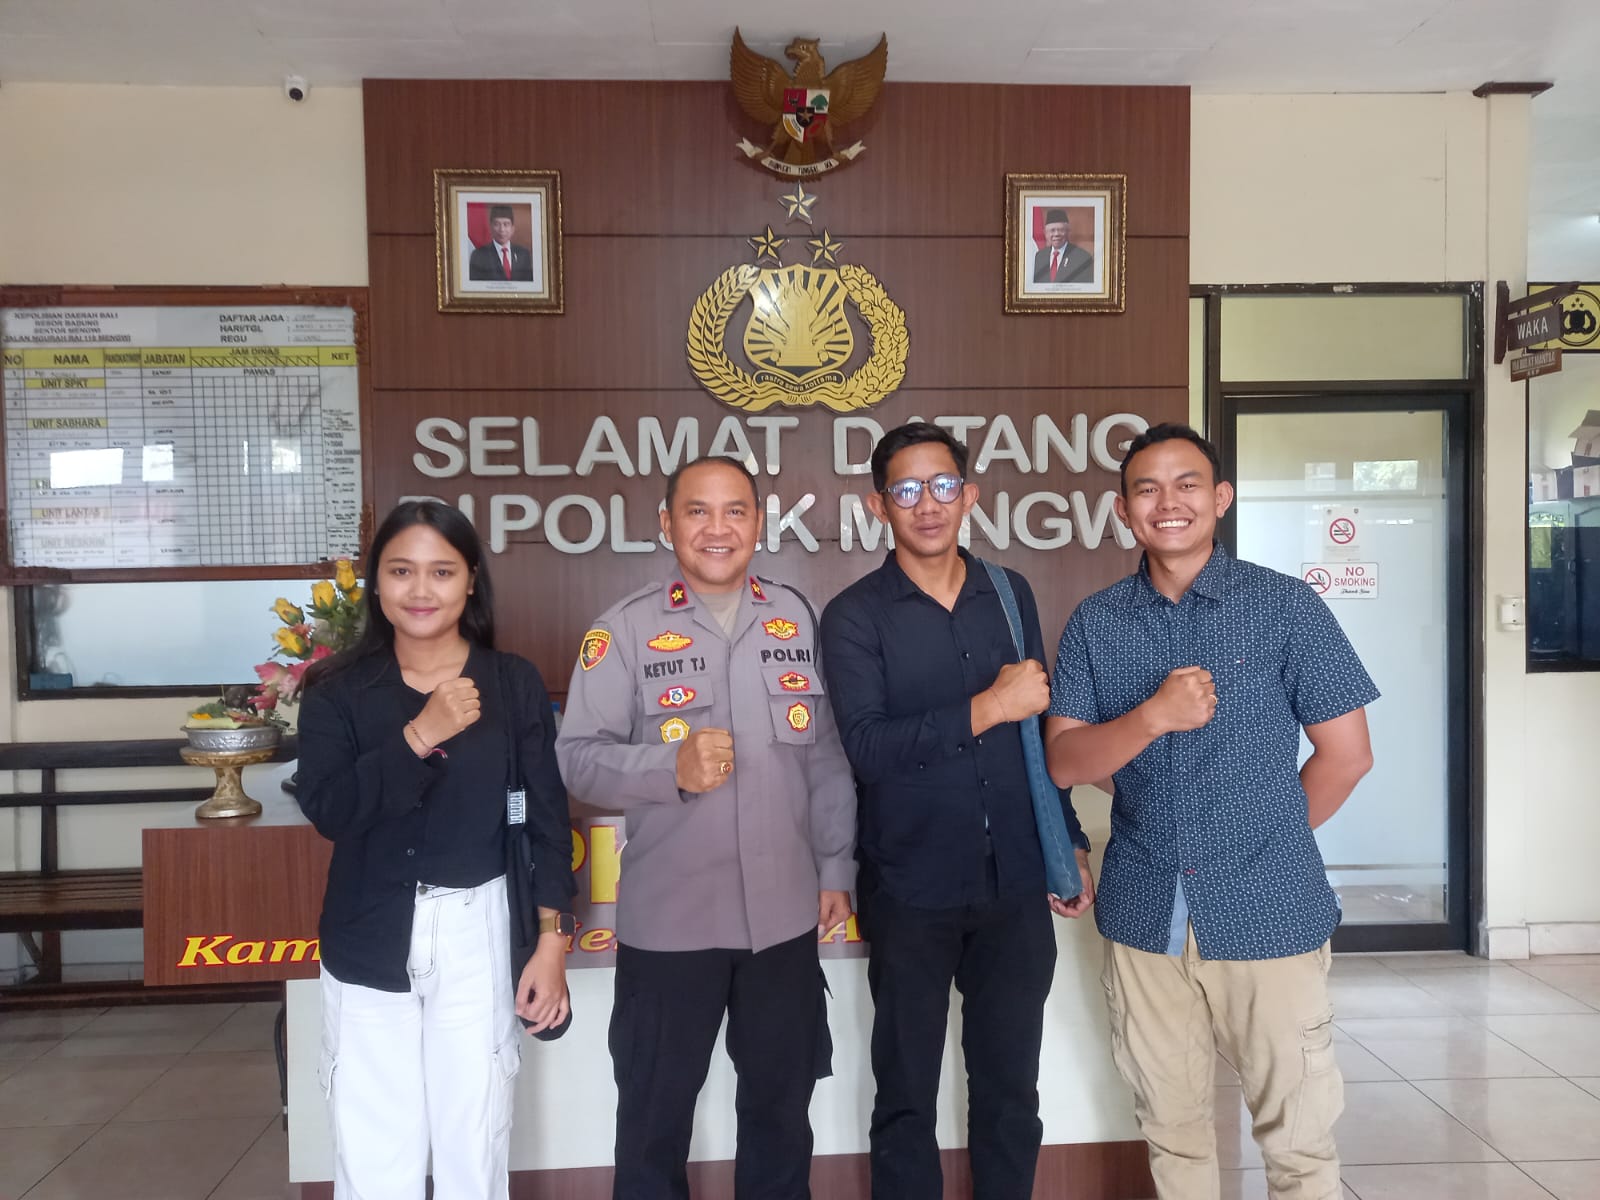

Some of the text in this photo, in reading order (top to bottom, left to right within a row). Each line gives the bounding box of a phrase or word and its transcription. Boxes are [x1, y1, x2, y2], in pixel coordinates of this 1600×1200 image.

[219, 314, 256, 323] DAFTAR
[258, 314, 285, 322] JAGA
[1517, 316, 1549, 340] WAKA
[220, 335, 248, 343] REGU
[4, 354, 22, 365] NO
[53, 354, 90, 365] NAMA
[144, 353, 186, 364] JABATAN
[331, 352, 350, 361] KET
[243, 368, 276, 377] PAWAS
[41, 378, 89, 389] UNIT SPKT
[32, 418, 102, 429] UNIT SABHARA
[412, 413, 1151, 478] SELAMAT DTANG
[490, 493, 821, 554] POLK
[839, 490, 1137, 552] MNGW
[1345, 566, 1365, 577] NO
[1334, 577, 1376, 587] SMOKING
[760, 648, 811, 664] POLRI
[643, 656, 706, 679] KETUT TJ
[176, 934, 320, 968] Kam
